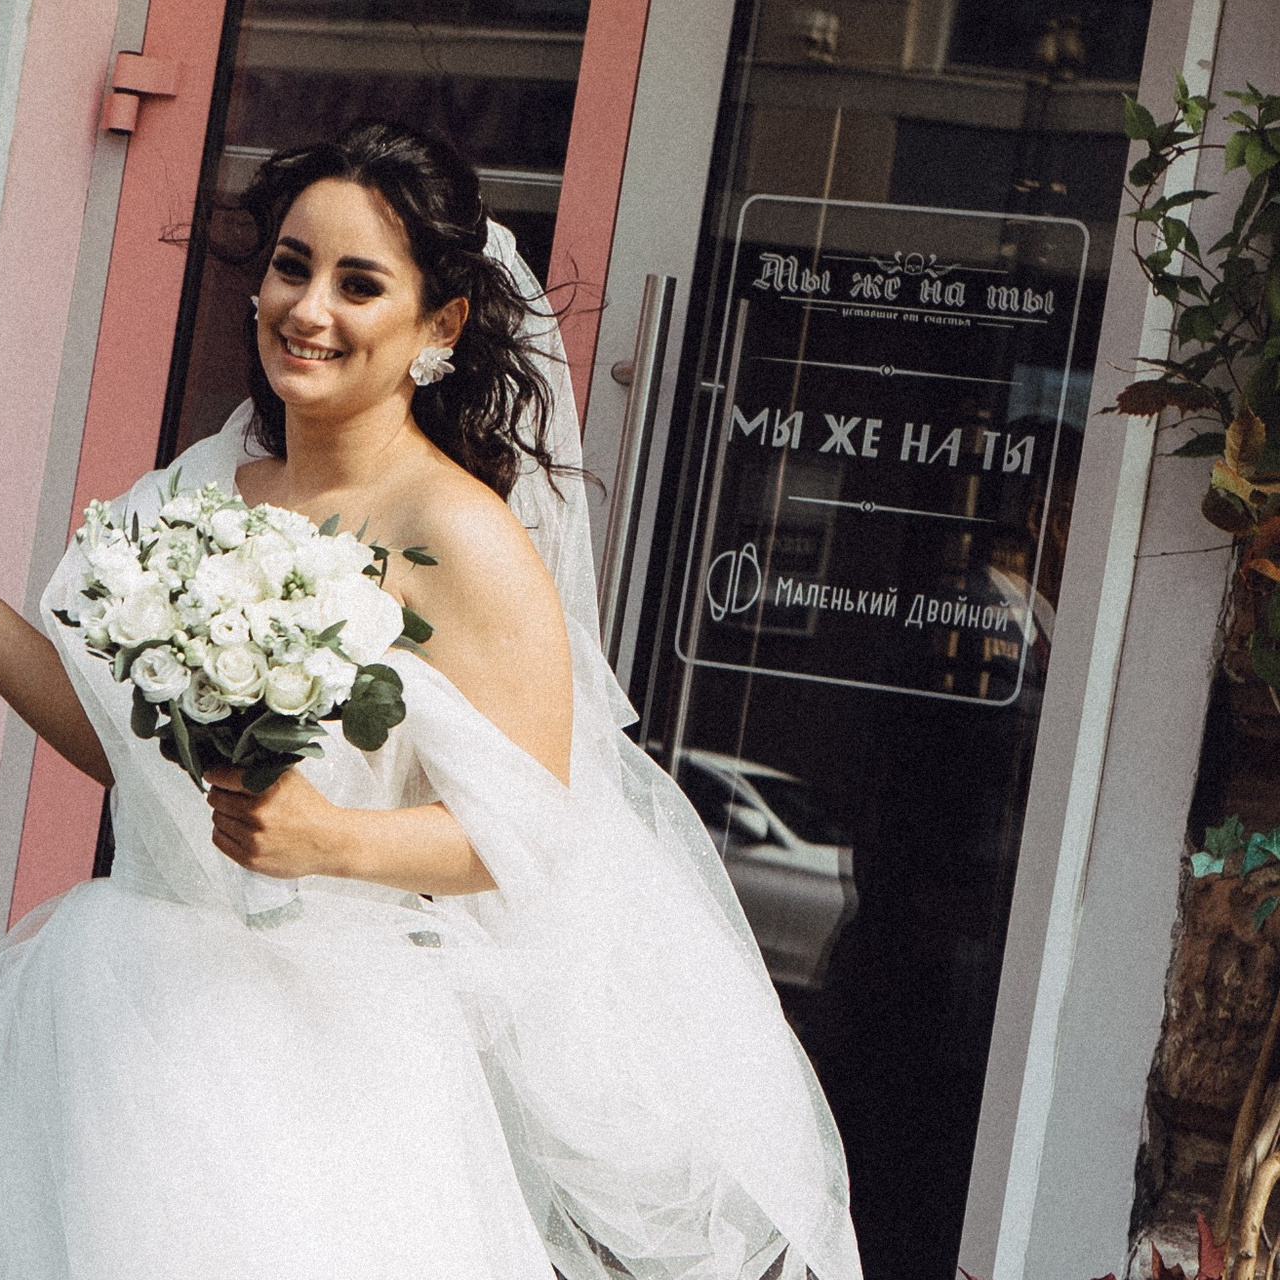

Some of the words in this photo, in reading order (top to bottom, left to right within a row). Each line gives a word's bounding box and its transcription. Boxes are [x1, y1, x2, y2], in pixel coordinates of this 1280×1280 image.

[753, 251, 831, 294] Мы
[849, 271, 902, 301] же
[919, 278, 966, 307] на
[986, 284, 1056, 314] ты
[903, 314, 919, 323] от
[924, 315, 971, 327] счастья
[728, 404, 804, 449] МЫ
[819, 413, 883, 458] ЖЕ
[900, 422, 963, 467] НА
[983, 430, 1036, 475] ТЫ
